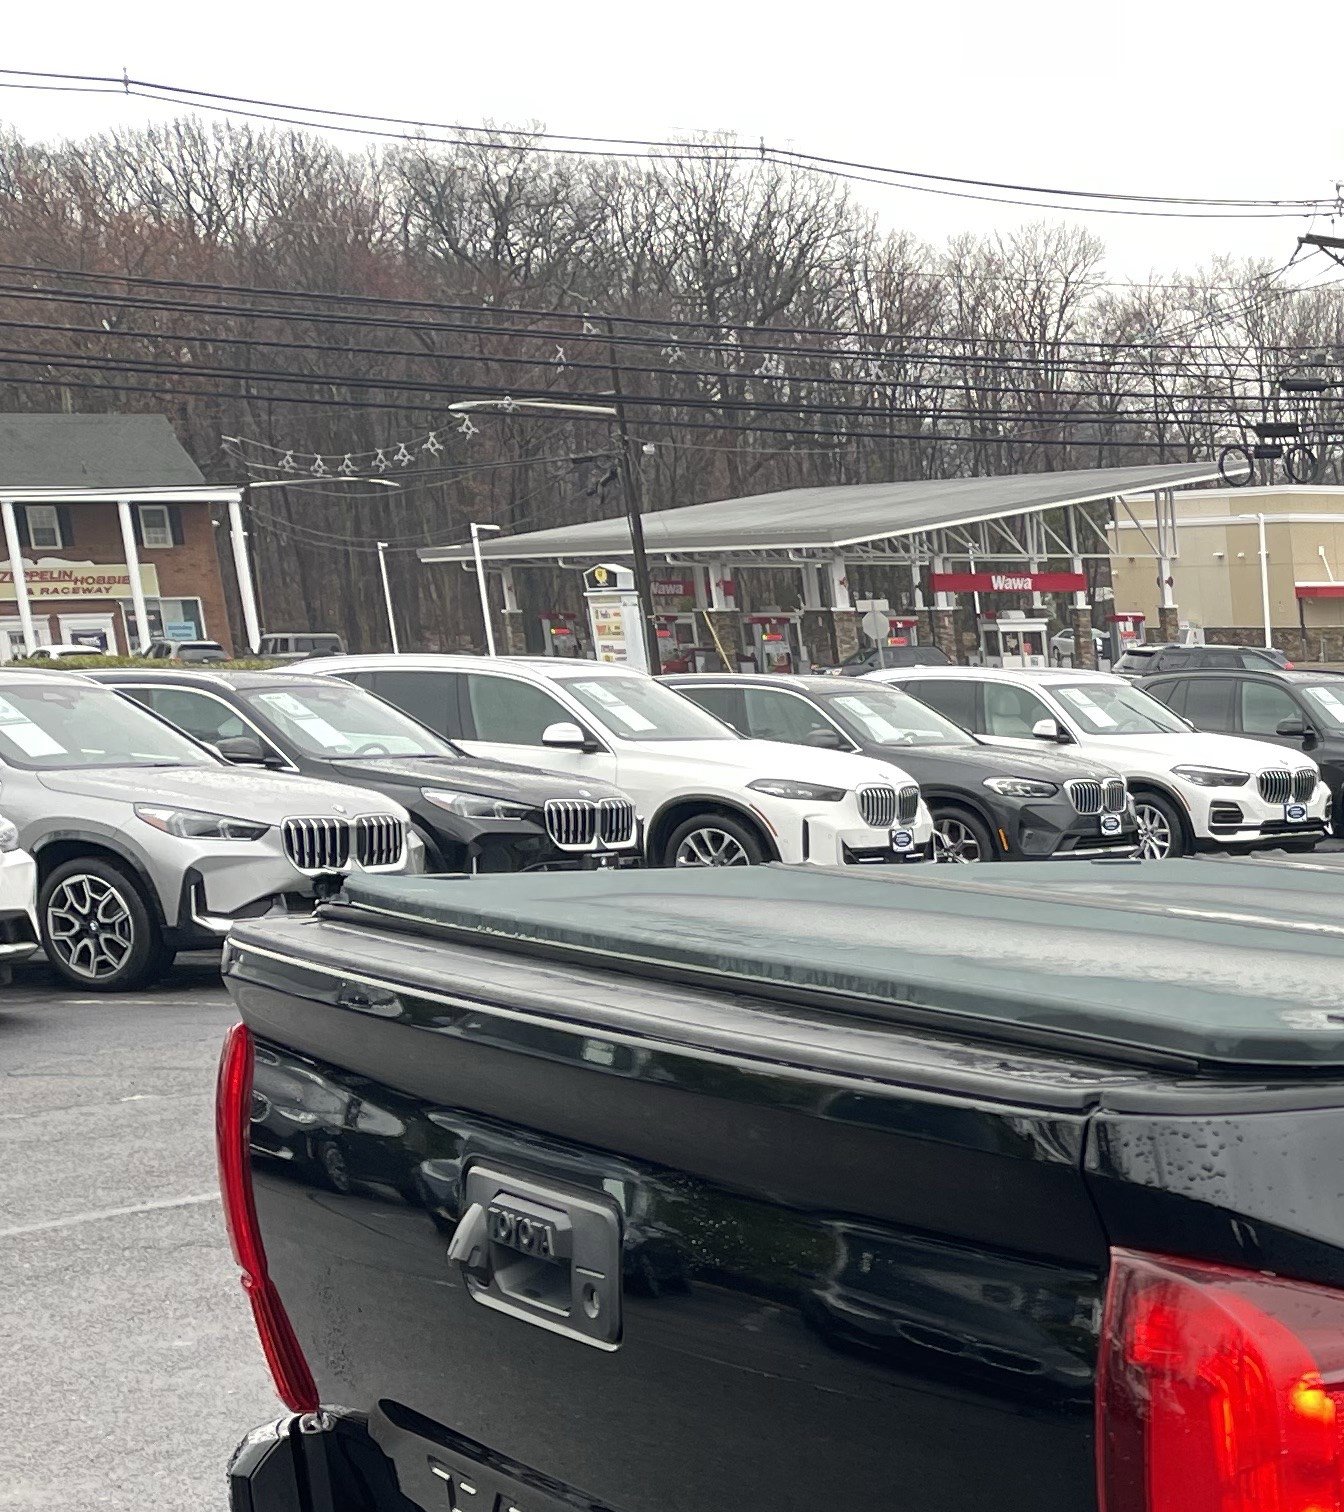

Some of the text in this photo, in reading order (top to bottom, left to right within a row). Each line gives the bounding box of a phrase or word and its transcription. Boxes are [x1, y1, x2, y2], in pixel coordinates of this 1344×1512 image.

[0, 569, 131, 586] ZPPELIN HOBBIE
[991, 574, 1033, 591] Wawa
[40, 586, 113, 595] RACEWAY
[487, 1206, 556, 1257] TOYOTA
